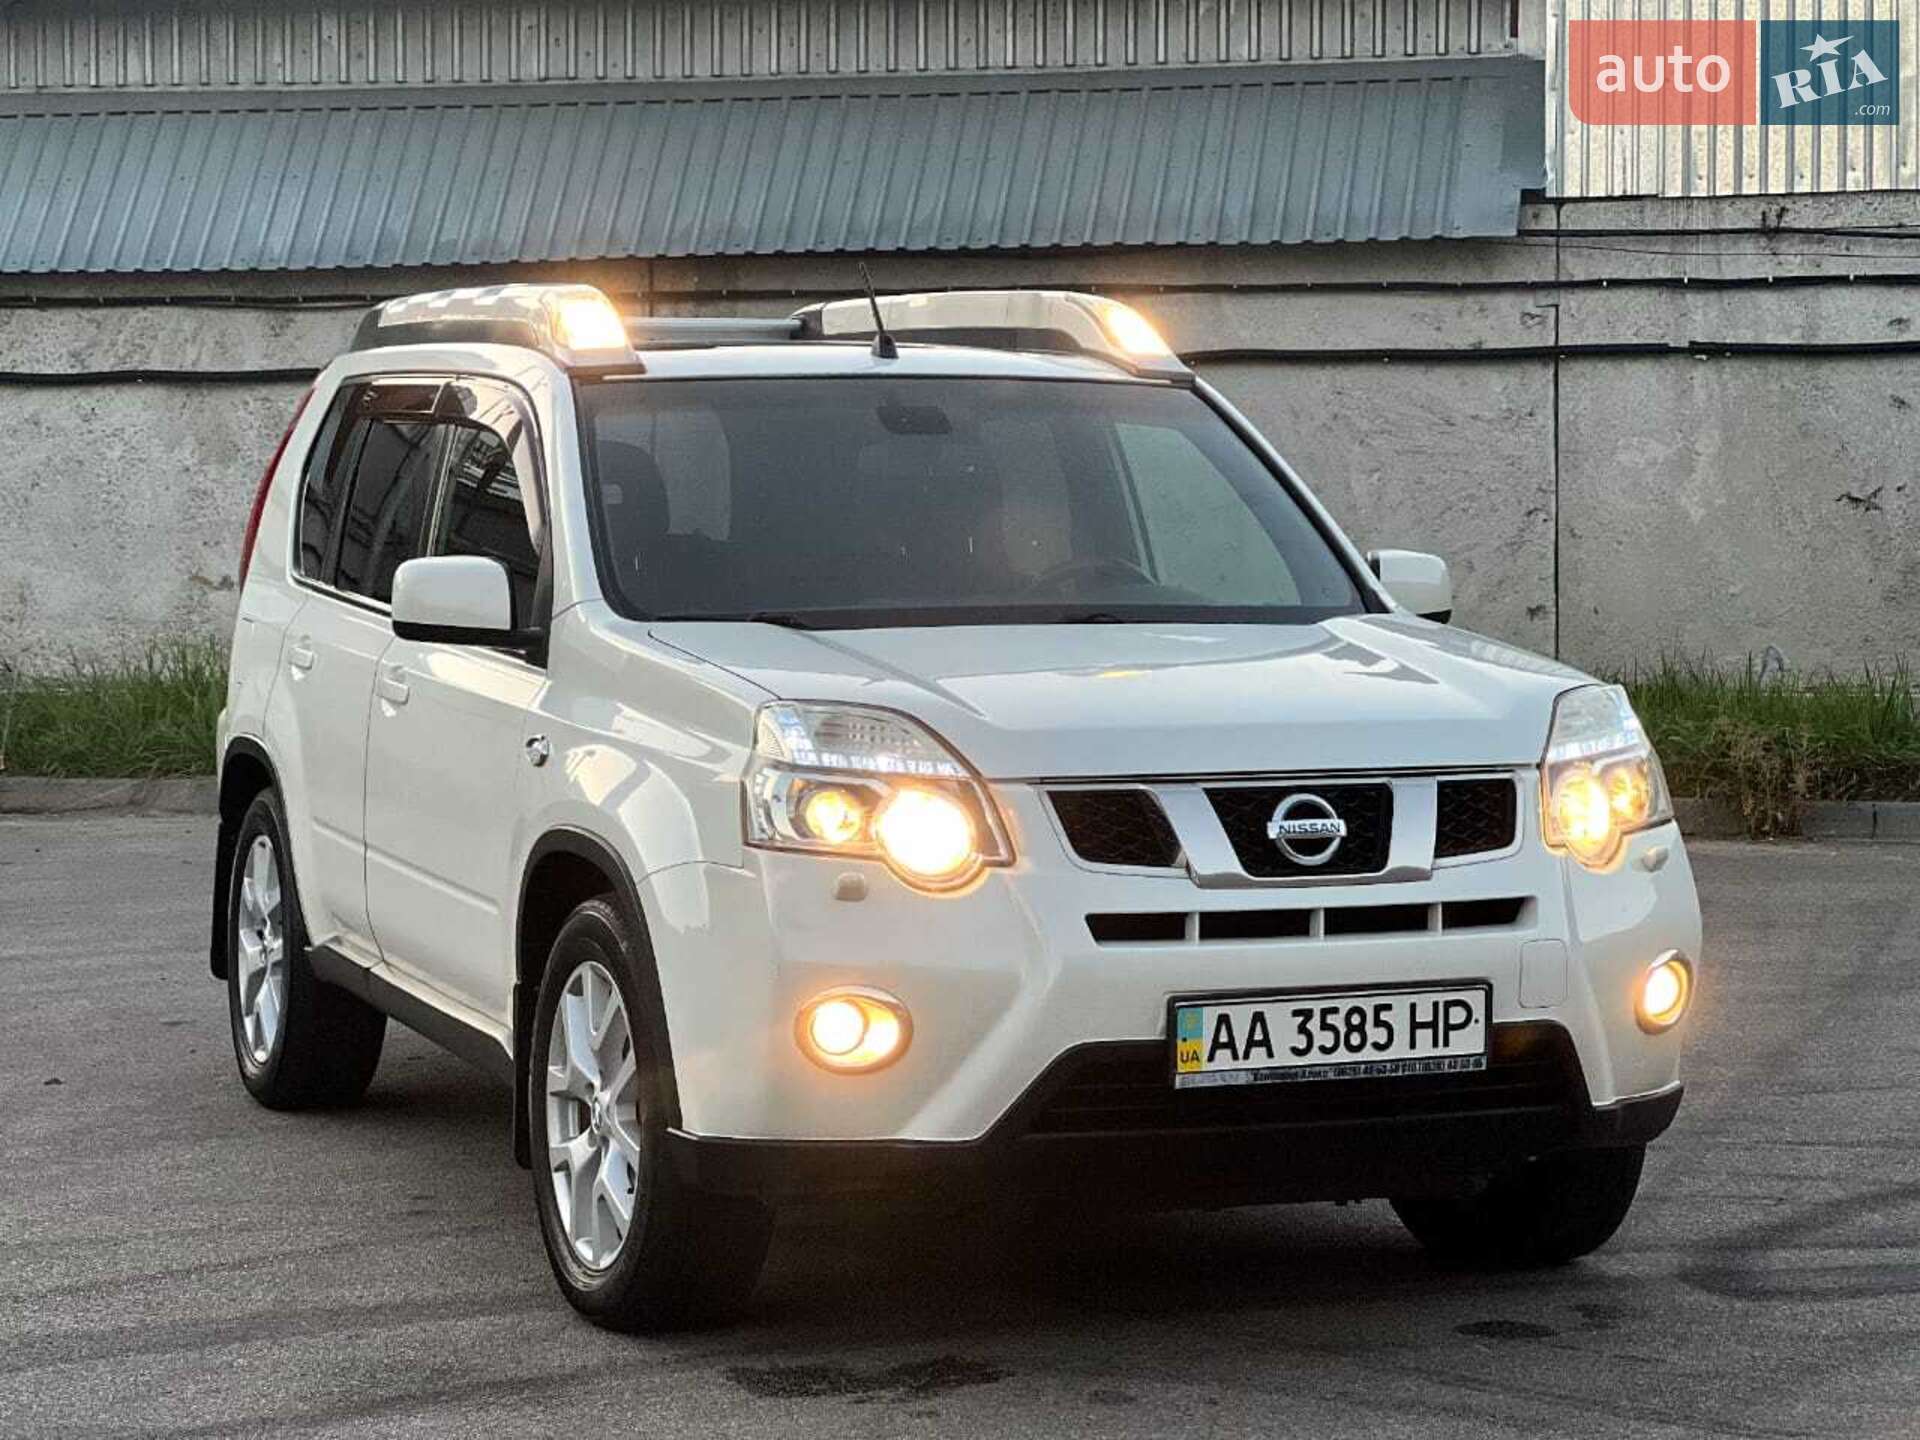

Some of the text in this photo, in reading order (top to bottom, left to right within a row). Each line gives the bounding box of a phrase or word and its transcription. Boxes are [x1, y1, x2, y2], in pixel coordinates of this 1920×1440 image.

[1278, 821, 1341, 835] NISSAN
[1206, 998, 1474, 1063] AA 3585 HP
[1179, 1050, 1200, 1065] UA
